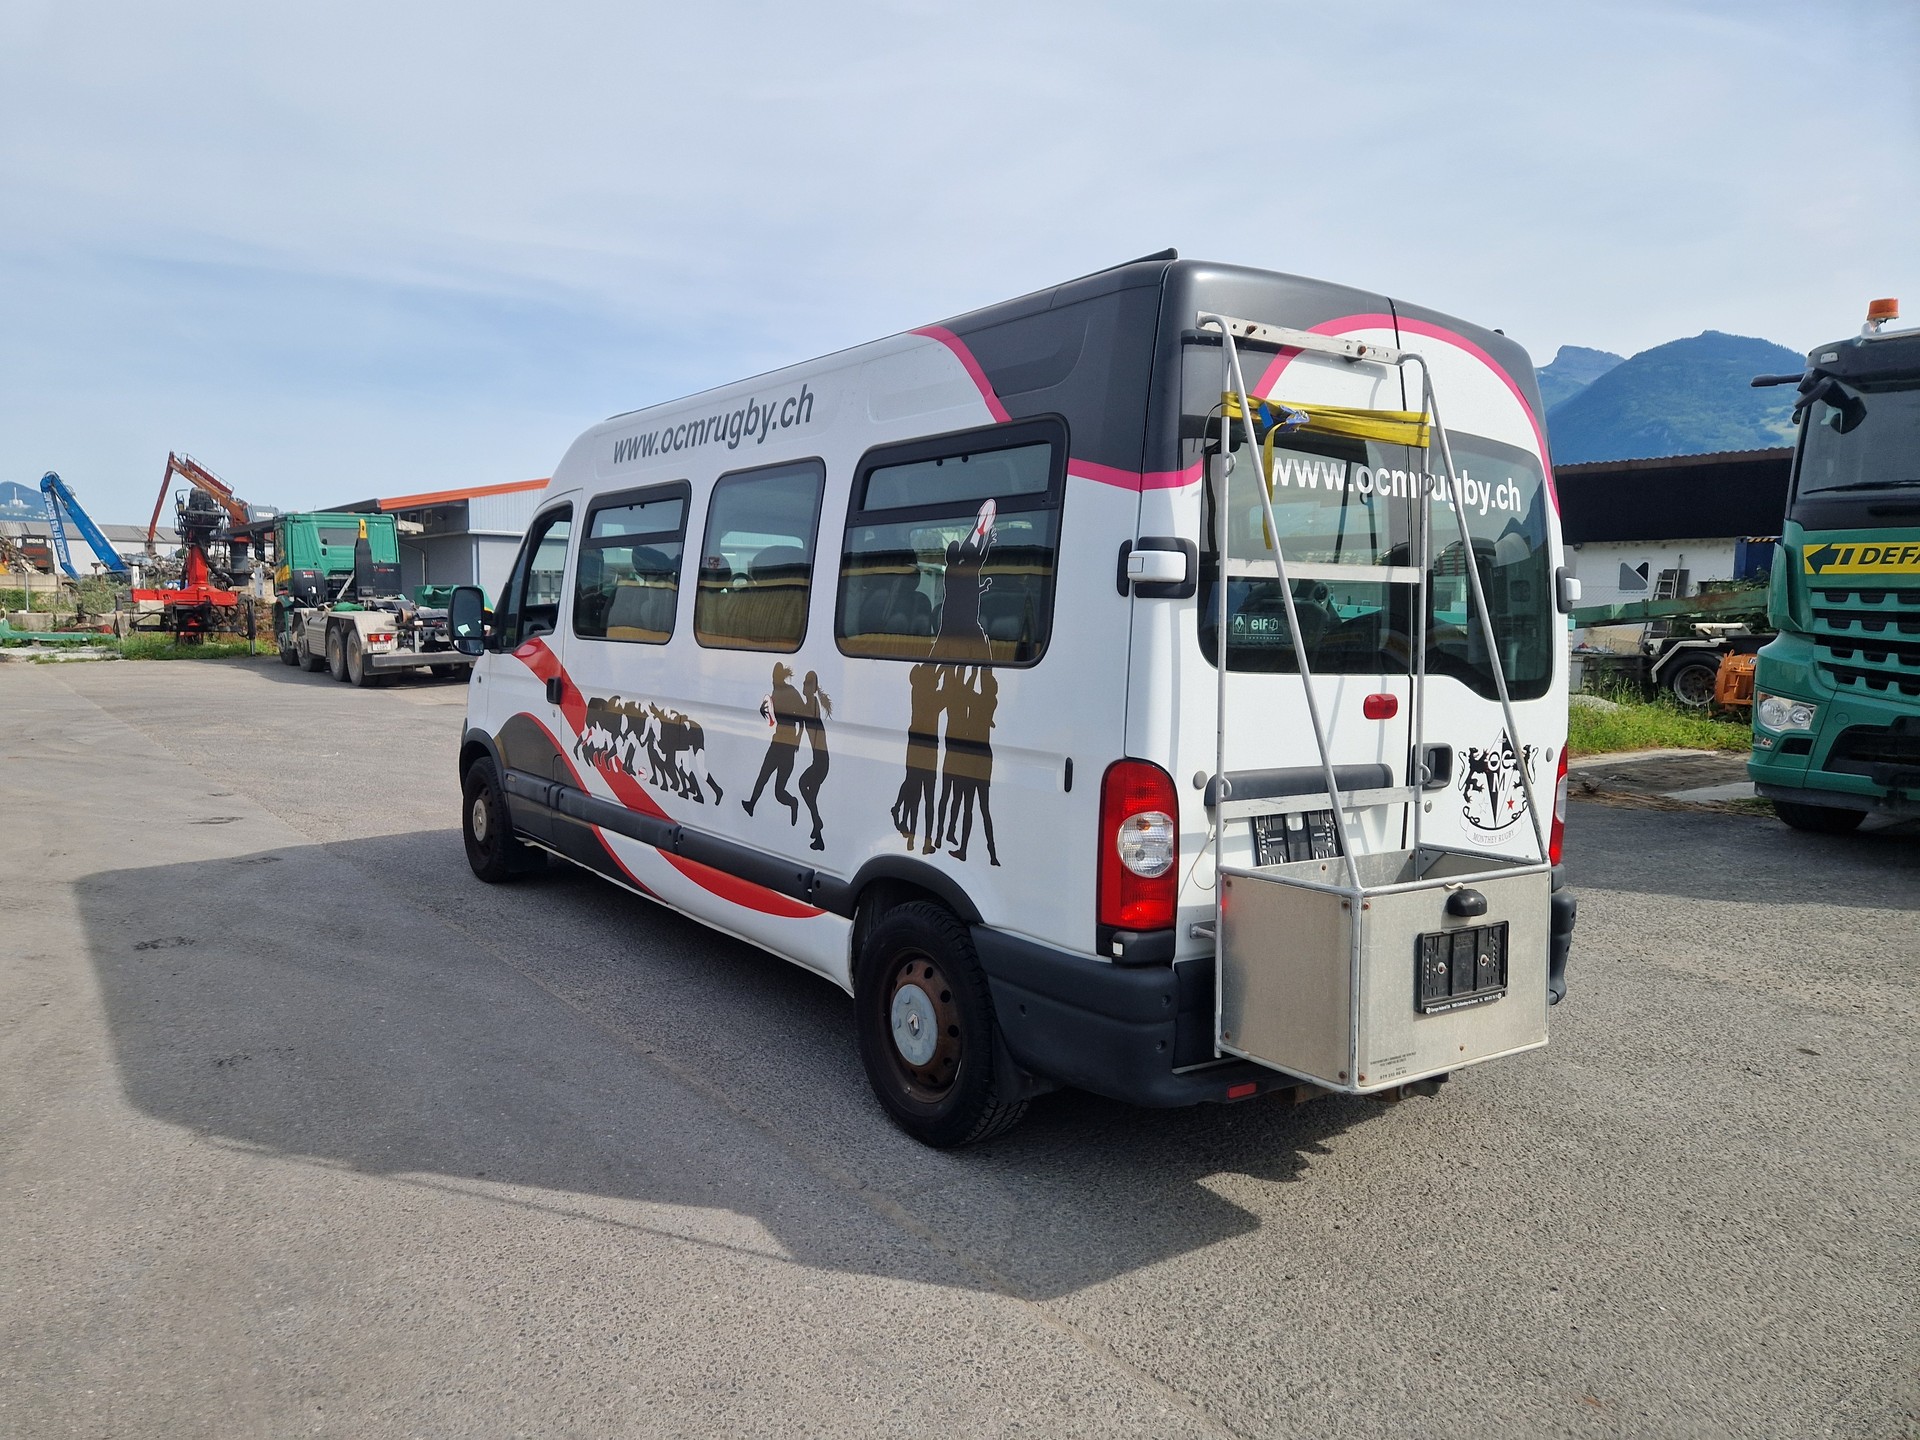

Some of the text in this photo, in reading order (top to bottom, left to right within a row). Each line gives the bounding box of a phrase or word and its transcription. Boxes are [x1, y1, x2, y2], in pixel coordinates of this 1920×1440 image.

[613, 383, 814, 464] www.ocmrugby.ch
[1272, 457, 1521, 516] www.ocmugby.ch
[1251, 618, 1268, 630] elf
